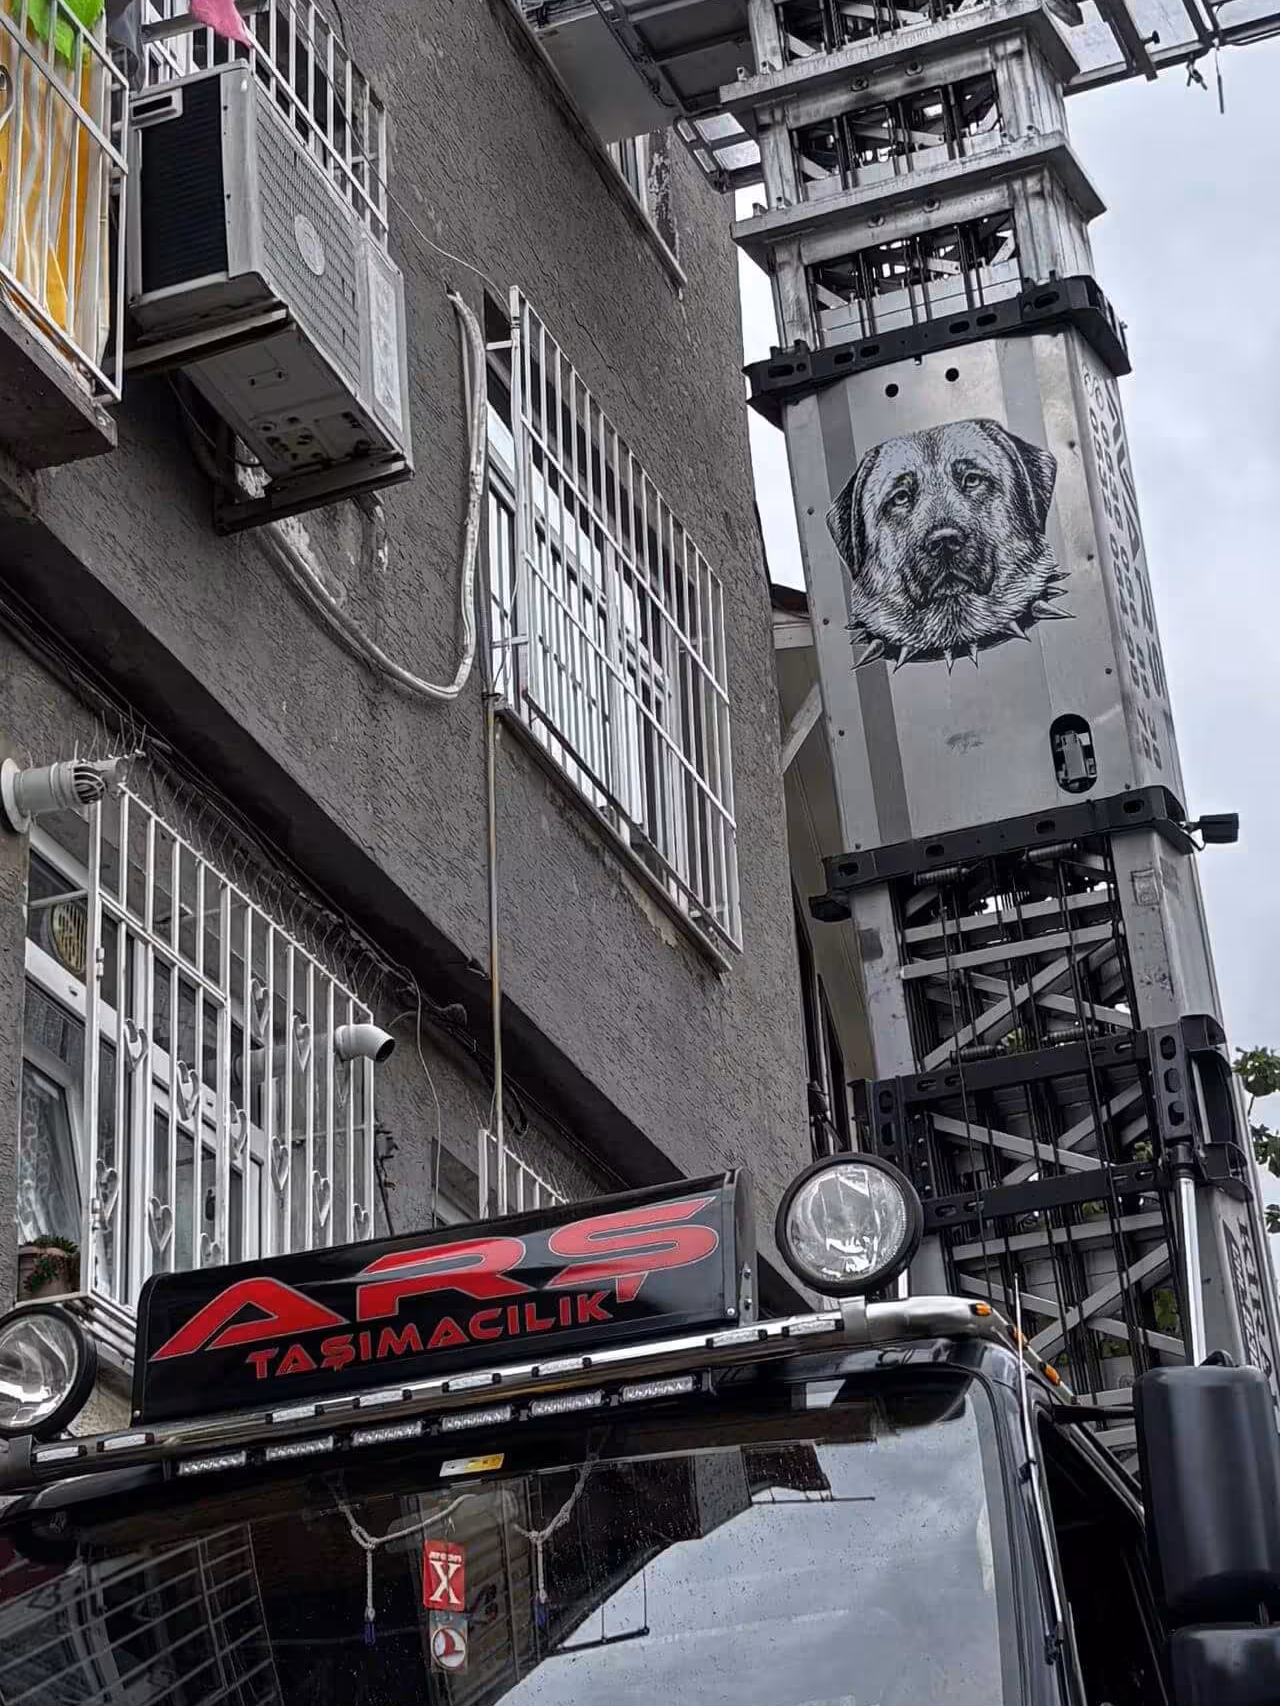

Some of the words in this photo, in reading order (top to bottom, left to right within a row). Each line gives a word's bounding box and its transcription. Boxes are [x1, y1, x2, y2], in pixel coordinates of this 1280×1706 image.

[151, 1195, 718, 1361] ARŞ
[245, 1290, 616, 1376] TAŞIMACILIK
[428, 1560, 462, 1604] X
